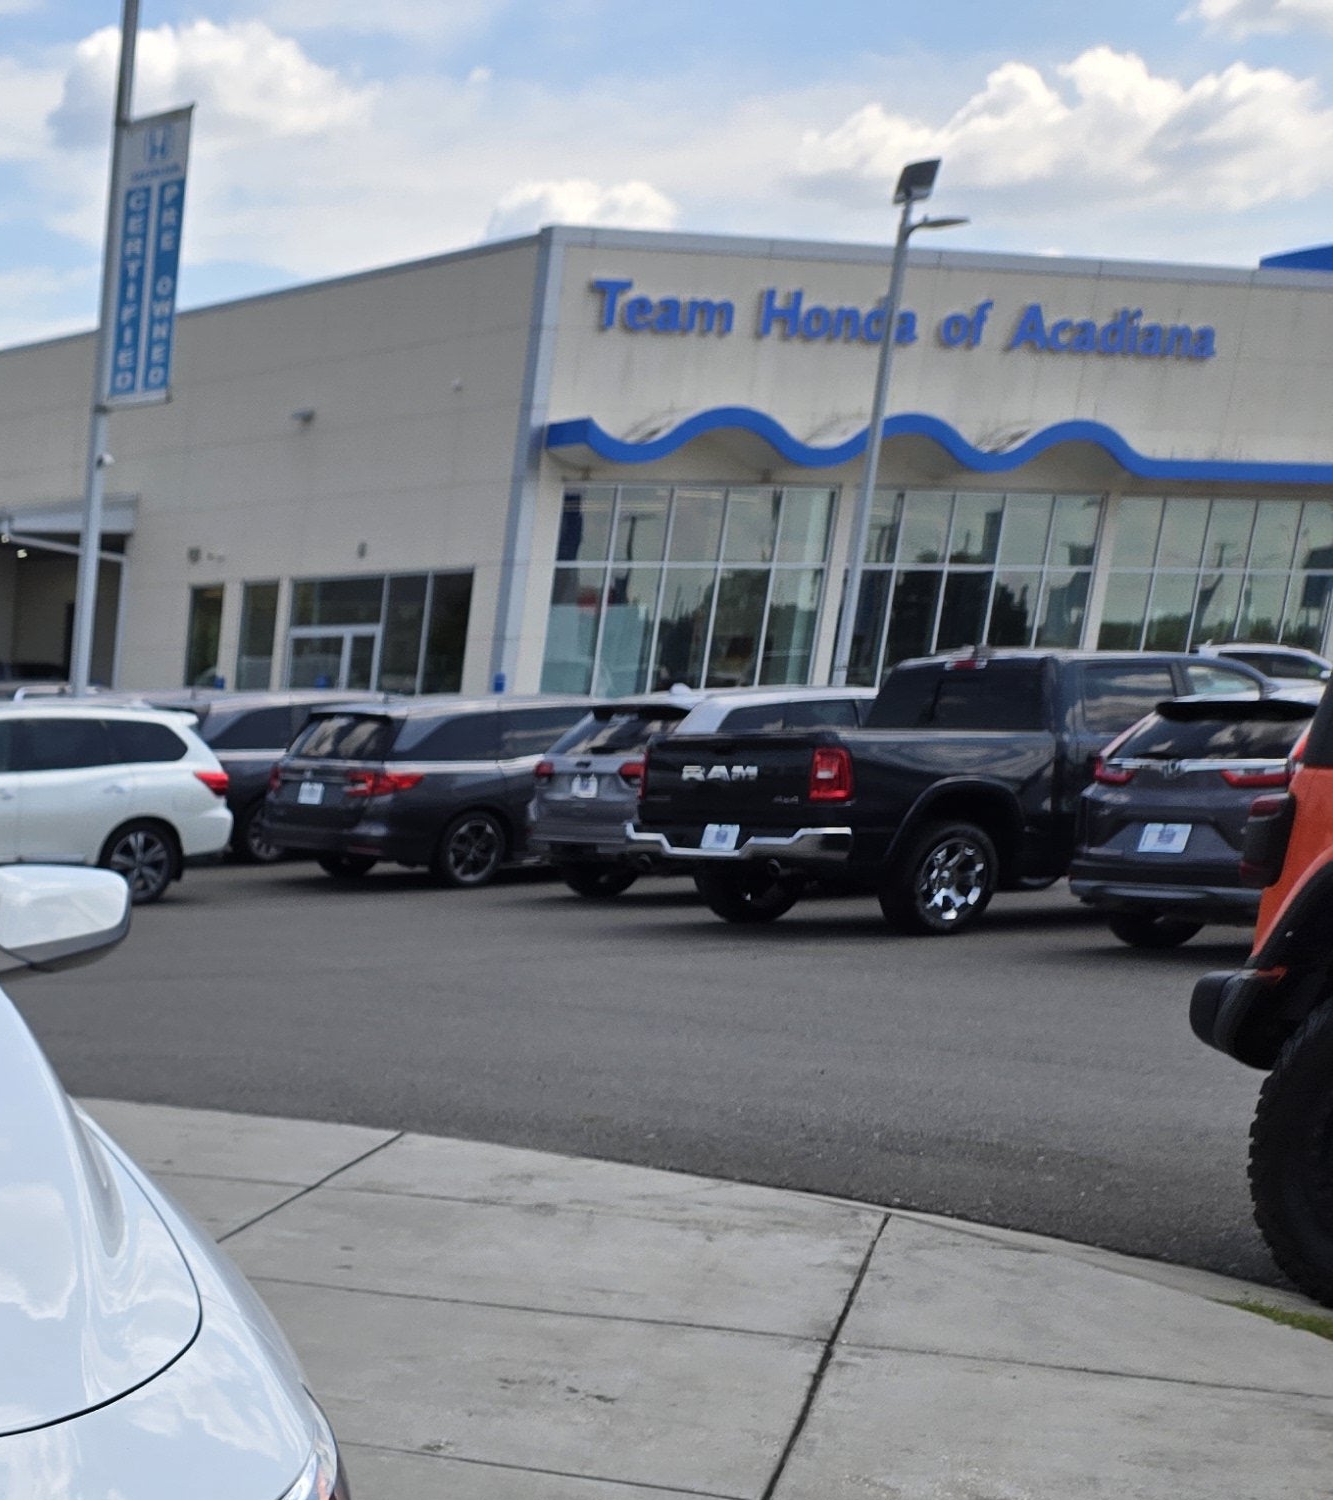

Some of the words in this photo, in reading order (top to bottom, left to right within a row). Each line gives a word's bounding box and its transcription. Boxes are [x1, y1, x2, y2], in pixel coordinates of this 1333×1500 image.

[159, 184, 181, 251] PRE
[114, 190, 148, 390] CERTIFIED
[147, 274, 174, 386] OWNED
[591, 278, 734, 333] Team
[760, 288, 918, 344] Honda
[941, 299, 994, 348] of
[1008, 303, 1217, 359] Acadiana
[681, 765, 759, 782] RAM
